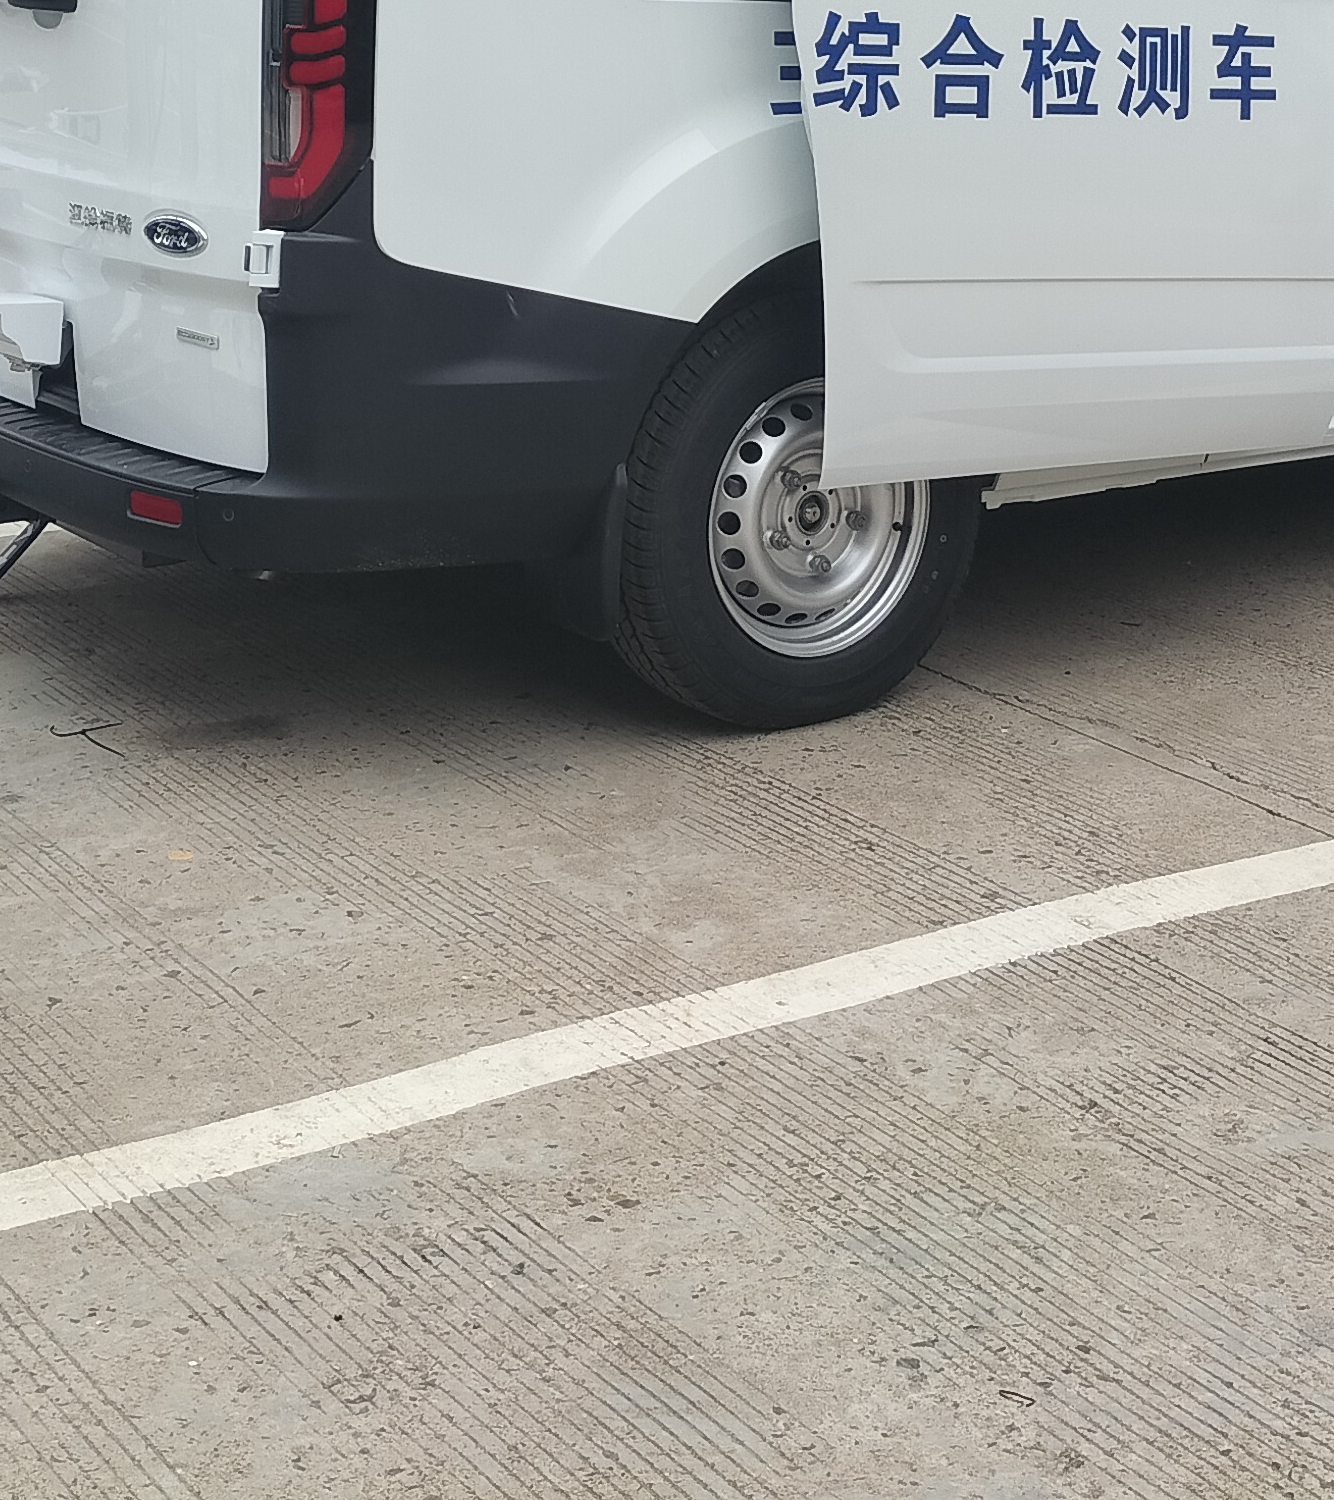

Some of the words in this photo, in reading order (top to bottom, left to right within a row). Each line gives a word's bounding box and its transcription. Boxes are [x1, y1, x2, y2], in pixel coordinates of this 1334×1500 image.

[812, 10, 1278, 121] 综合检测车
